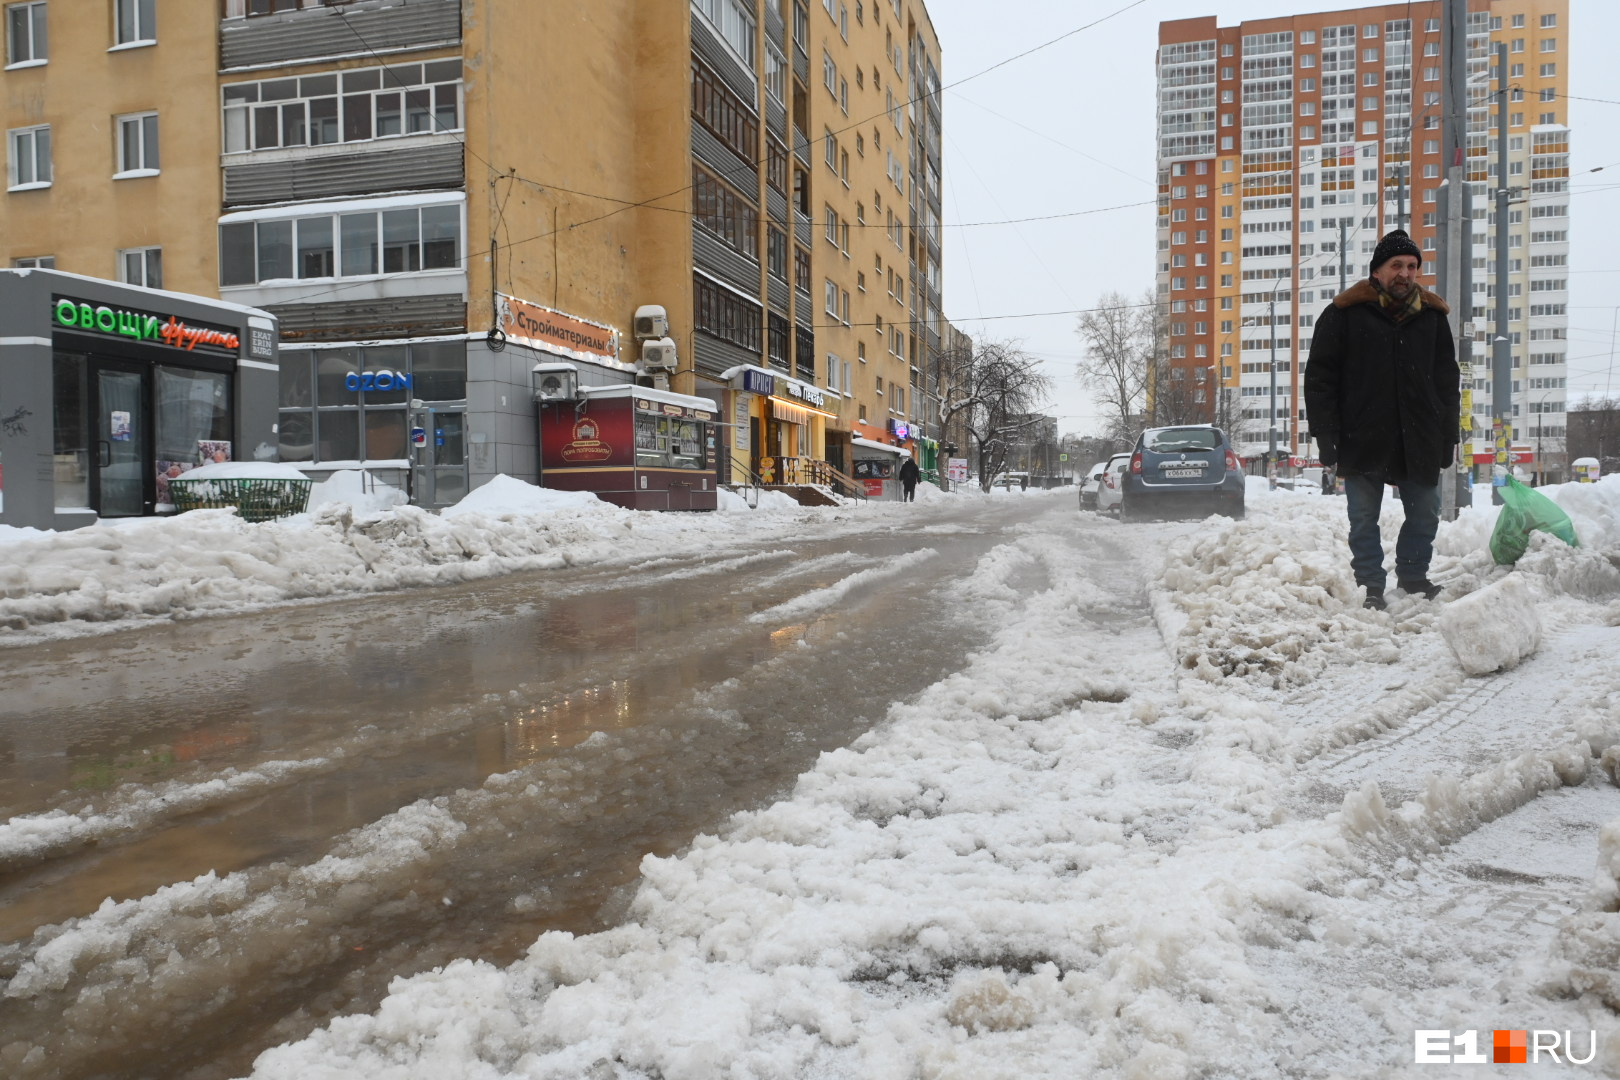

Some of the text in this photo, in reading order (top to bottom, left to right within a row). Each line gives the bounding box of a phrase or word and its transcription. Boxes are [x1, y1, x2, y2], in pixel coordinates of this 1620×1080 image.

[56, 300, 240, 351] ОВОЩИ фрукты
[517, 312, 605, 351] Стройматериалы
[252, 331, 272, 341] EKAT
[252, 338, 272, 348] ERIN
[252, 346, 272, 356] BURG
[345, 372, 413, 392] OZON
[751, 371, 772, 394] ЮРИСТ
[803, 387, 824, 408] Пекарь
